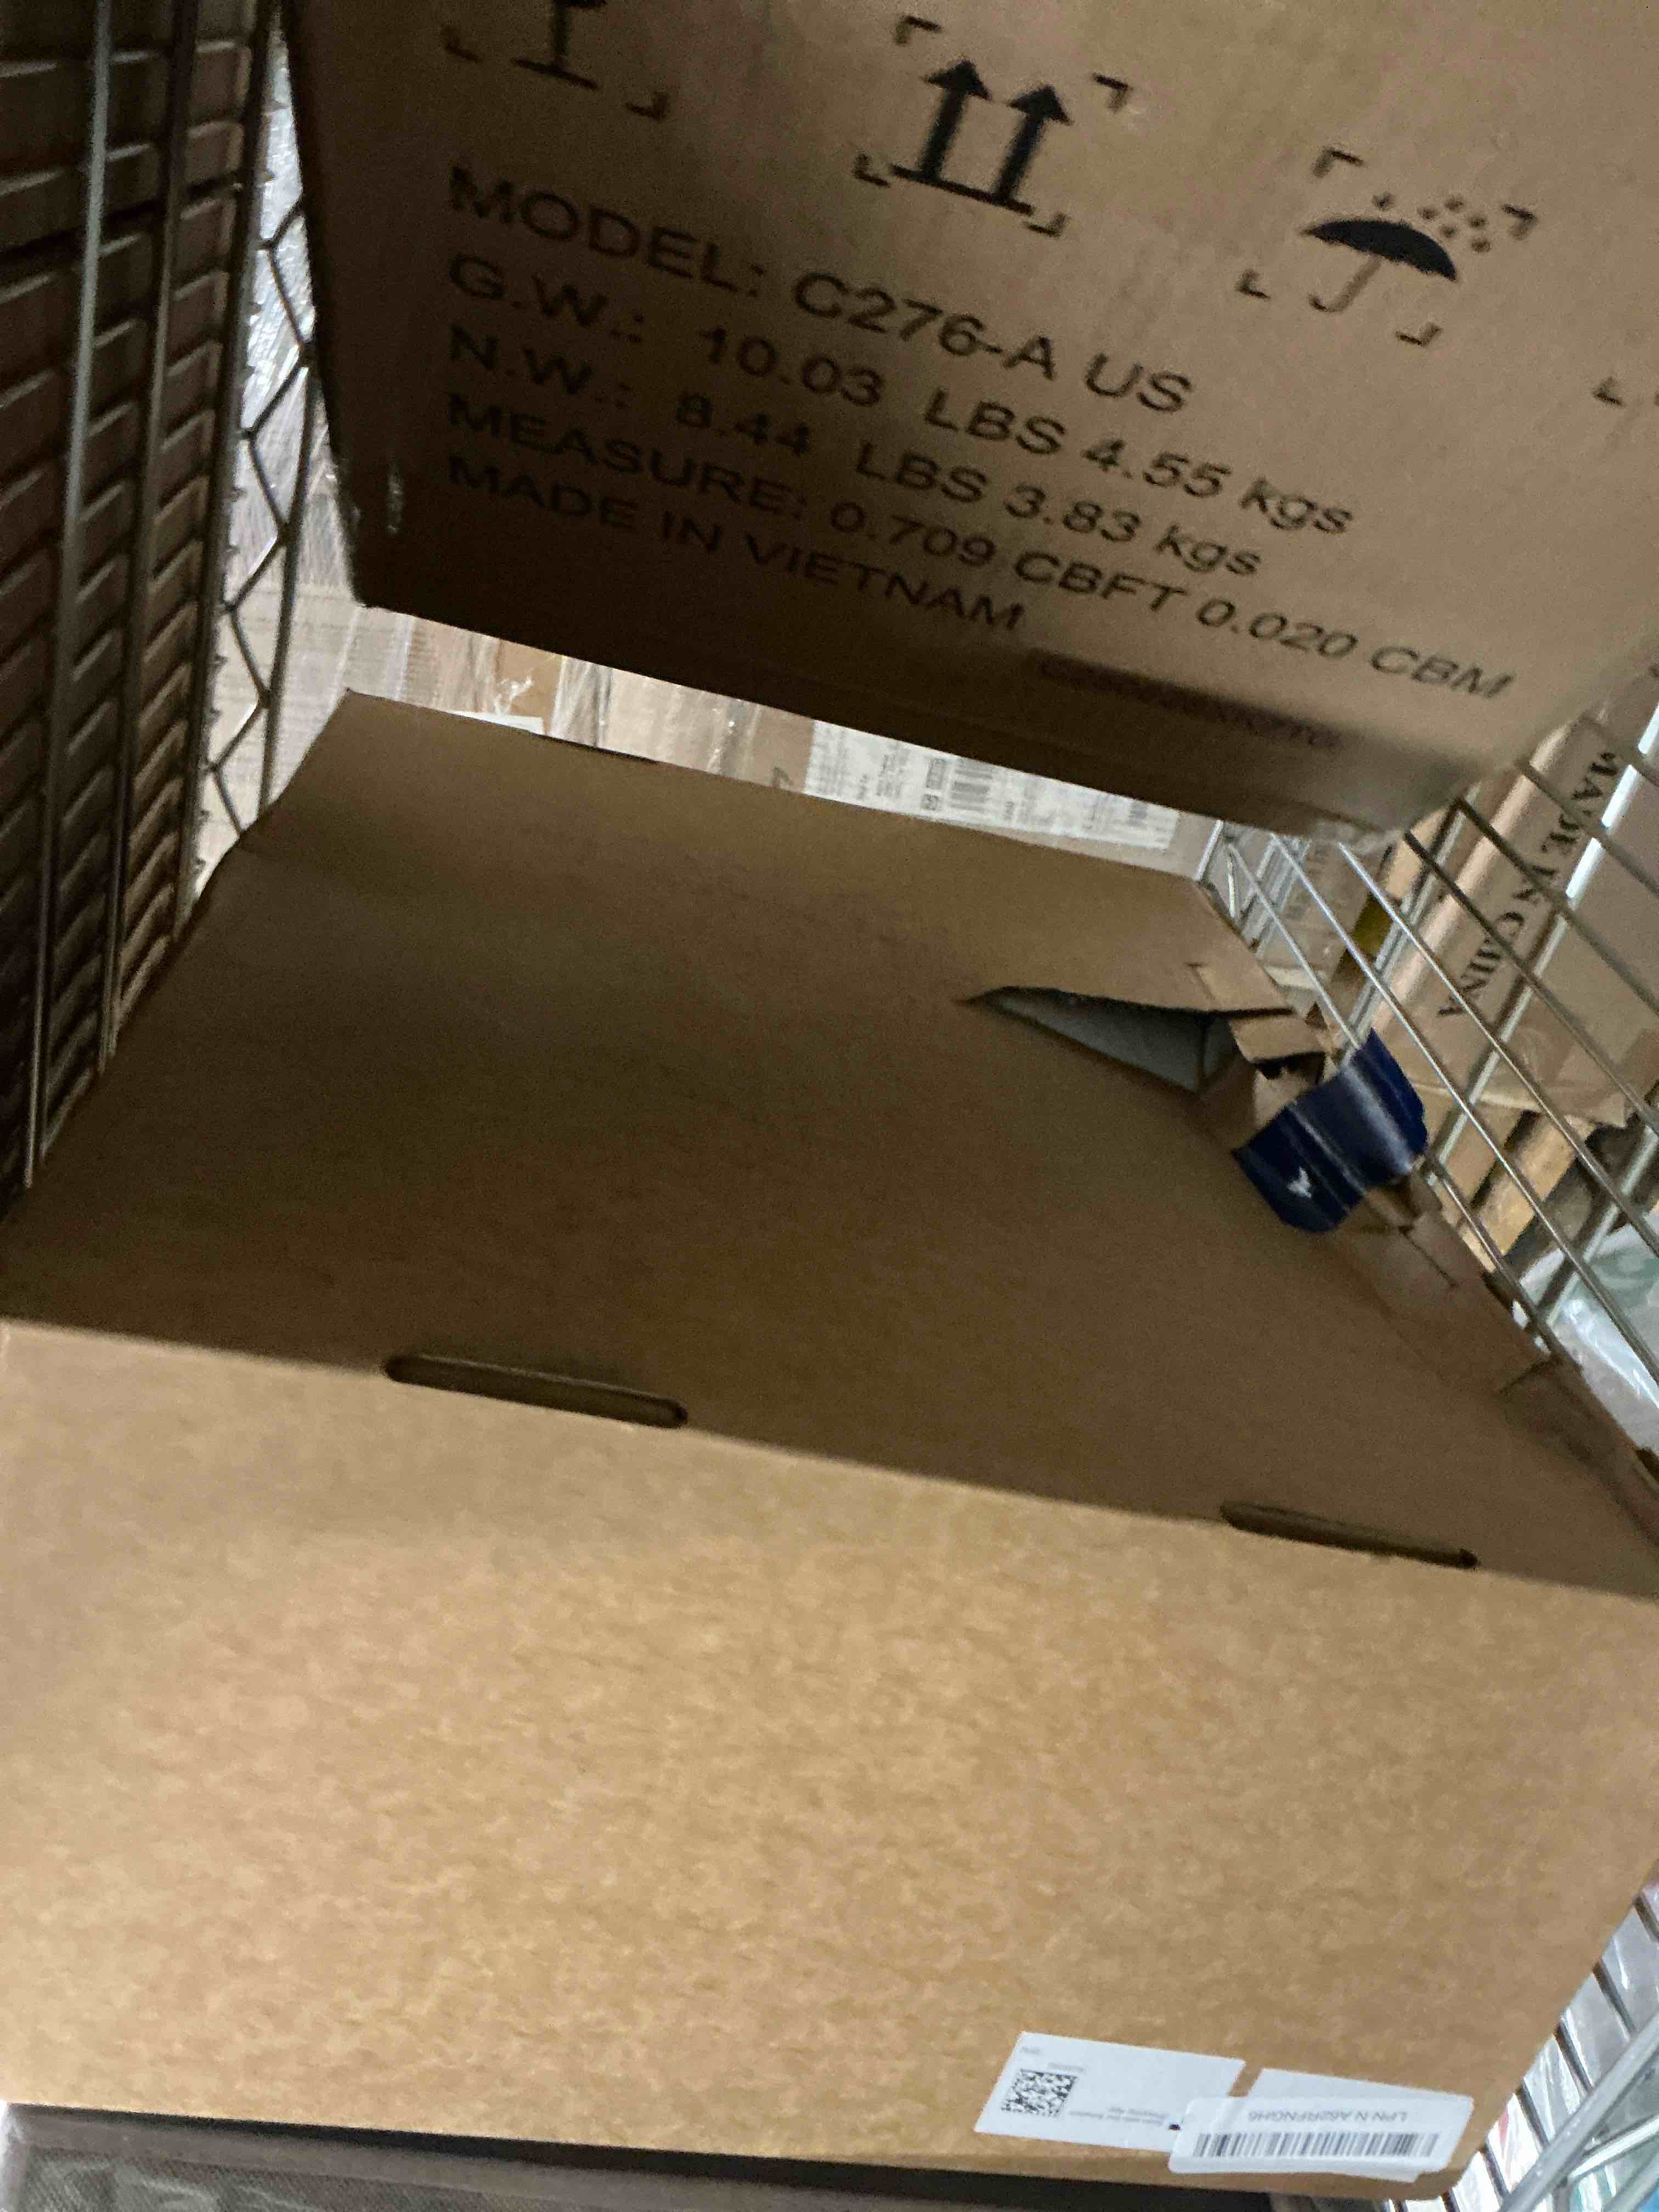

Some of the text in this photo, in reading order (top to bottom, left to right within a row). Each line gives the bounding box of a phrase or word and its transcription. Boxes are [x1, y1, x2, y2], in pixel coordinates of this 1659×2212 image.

[450, 166, 1193, 413] MODEL: C276-A US
[676, 391, 810, 456] 8.44
[856, 442, 988, 503] LBS
[1004, 485, 1141, 543] 3.83
[701, 326, 883, 407] 10.03
[925, 387, 1066, 455] LBS
[1082, 438, 1231, 498] 4.55
[448, 456, 1025, 630] MADE IN VIETNAM
[448, 393, 1514, 699] MEASURE: 0.709 CBFT 0.020 CBM
